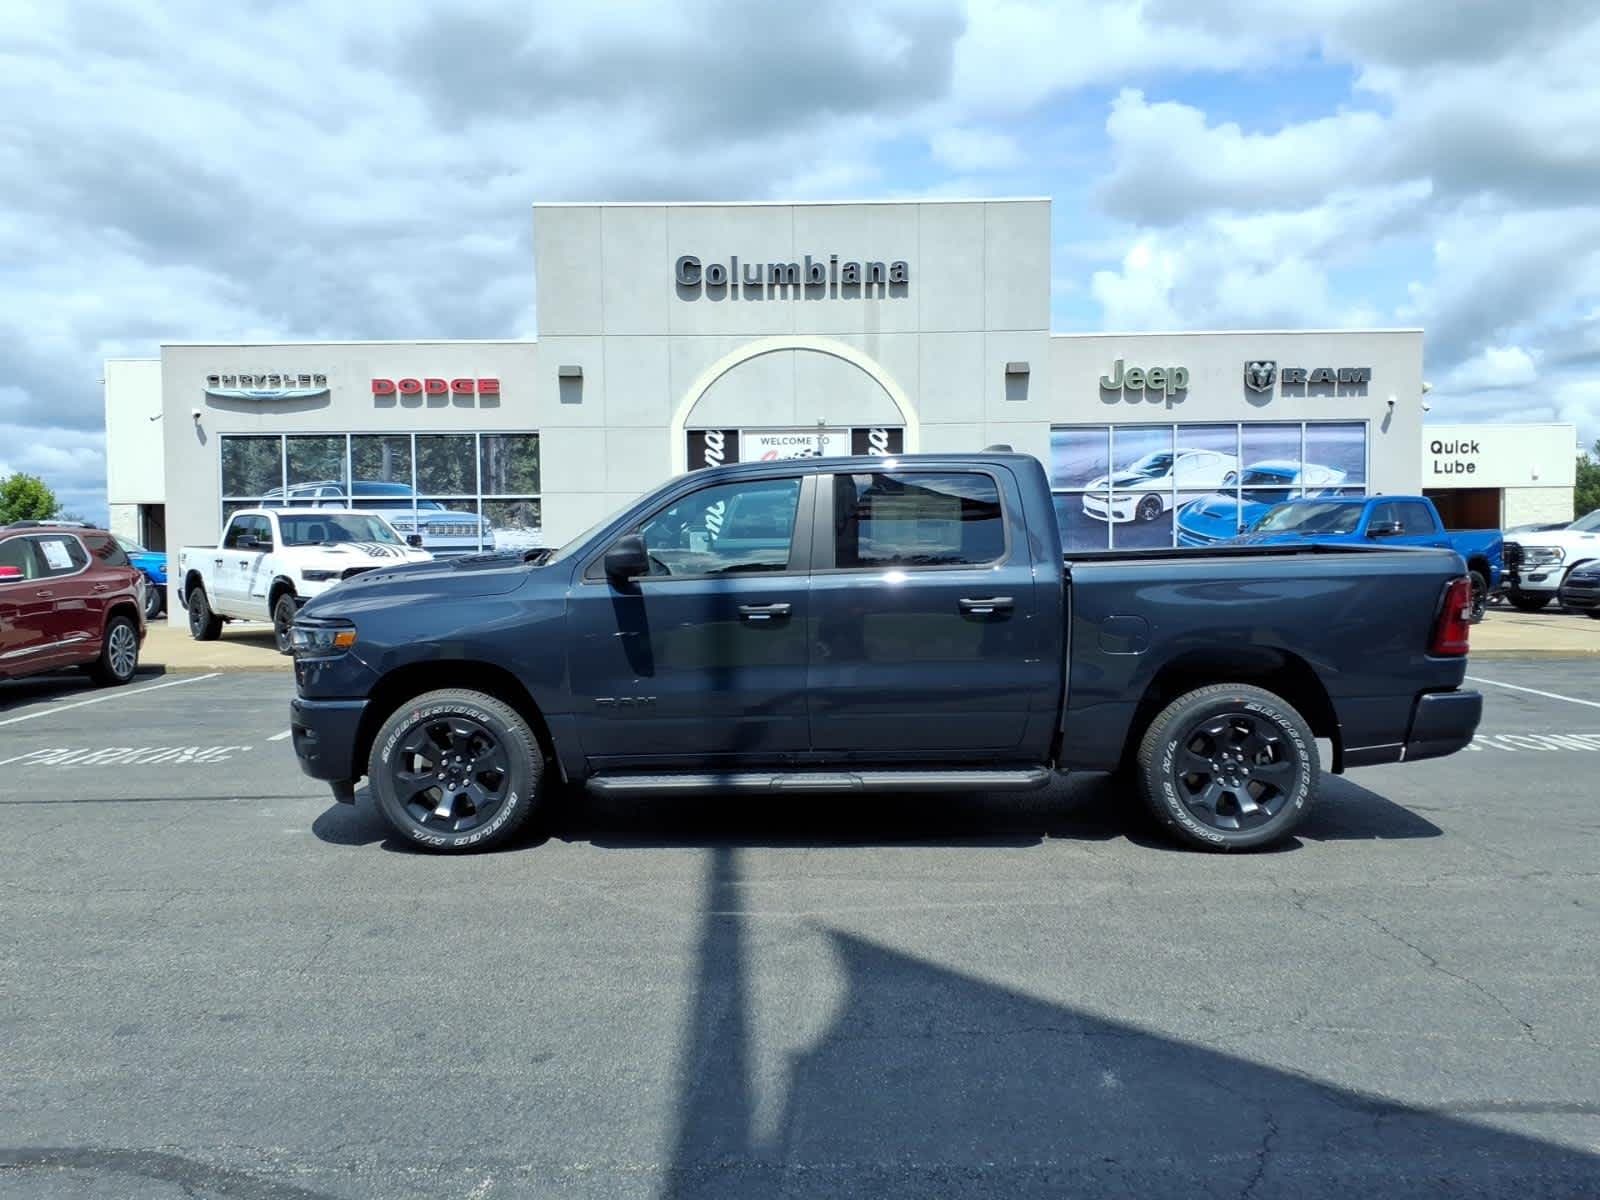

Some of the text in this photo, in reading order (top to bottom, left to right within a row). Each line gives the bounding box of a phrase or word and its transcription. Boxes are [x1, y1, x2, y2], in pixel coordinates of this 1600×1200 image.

[675, 254, 908, 287] Columbiana
[206, 374, 327, 386] CHRYSLER
[1100, 359, 1190, 395] Jeep
[1281, 367, 1372, 385] RAM
[372, 378, 501, 395] DODGE
[760, 437, 830, 445] WELCOME TO
[1430, 440, 1480, 454] Quick
[1434, 460, 1476, 474] Lube
[0, 746, 253, 766] PARKING
